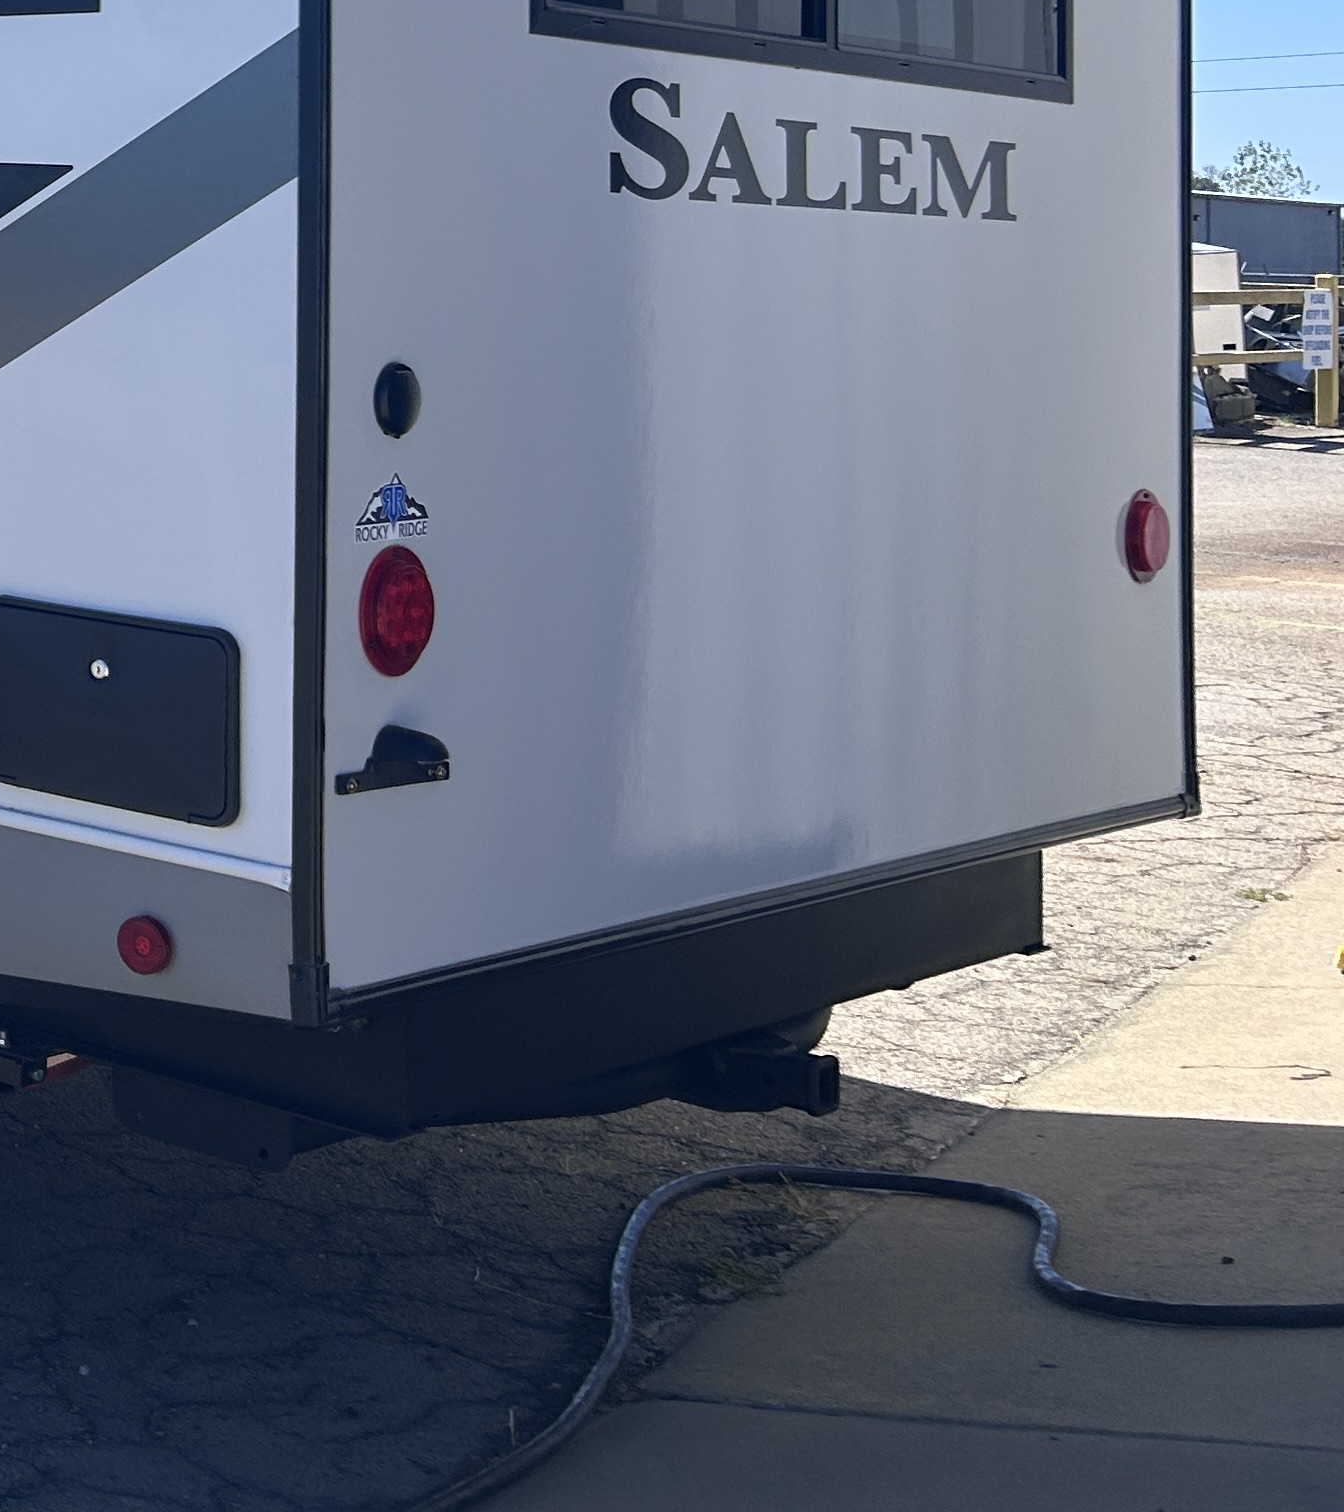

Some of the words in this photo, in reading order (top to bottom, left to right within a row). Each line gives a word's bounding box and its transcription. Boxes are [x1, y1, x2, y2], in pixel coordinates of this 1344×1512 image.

[609, 77, 1017, 221] SALEM
[355, 524, 390, 543] ROCKY
[398, 520, 428, 538] RIDGE
